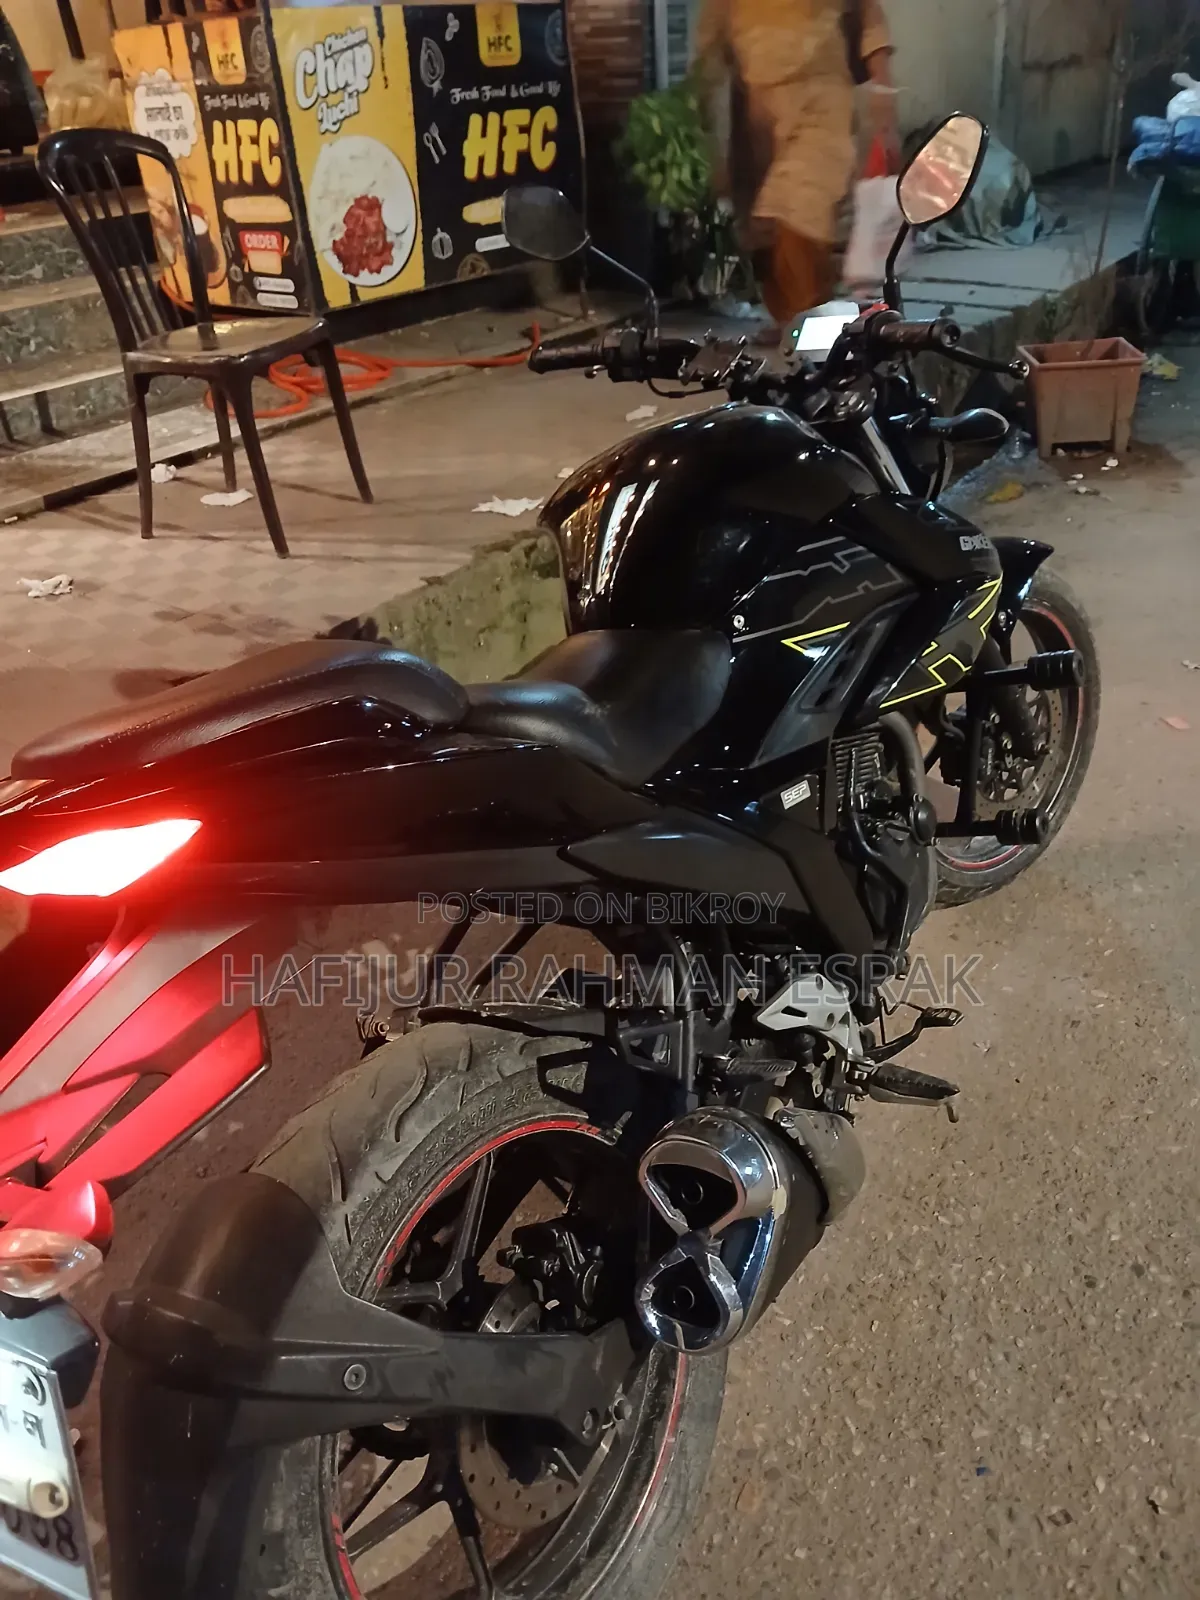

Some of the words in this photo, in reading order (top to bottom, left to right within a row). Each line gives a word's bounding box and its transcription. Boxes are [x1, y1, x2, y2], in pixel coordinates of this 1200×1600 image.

[487, 35, 513, 52] HFC
[216, 53, 239, 71] HFC
[296, 41, 374, 110] Chap
[318, 91, 360, 134] Luchi
[212, 117, 282, 187] HFC
[463, 105, 559, 181] HFC
[244, 233, 280, 249] ORDER
[784, 783, 807, 804] SEP
